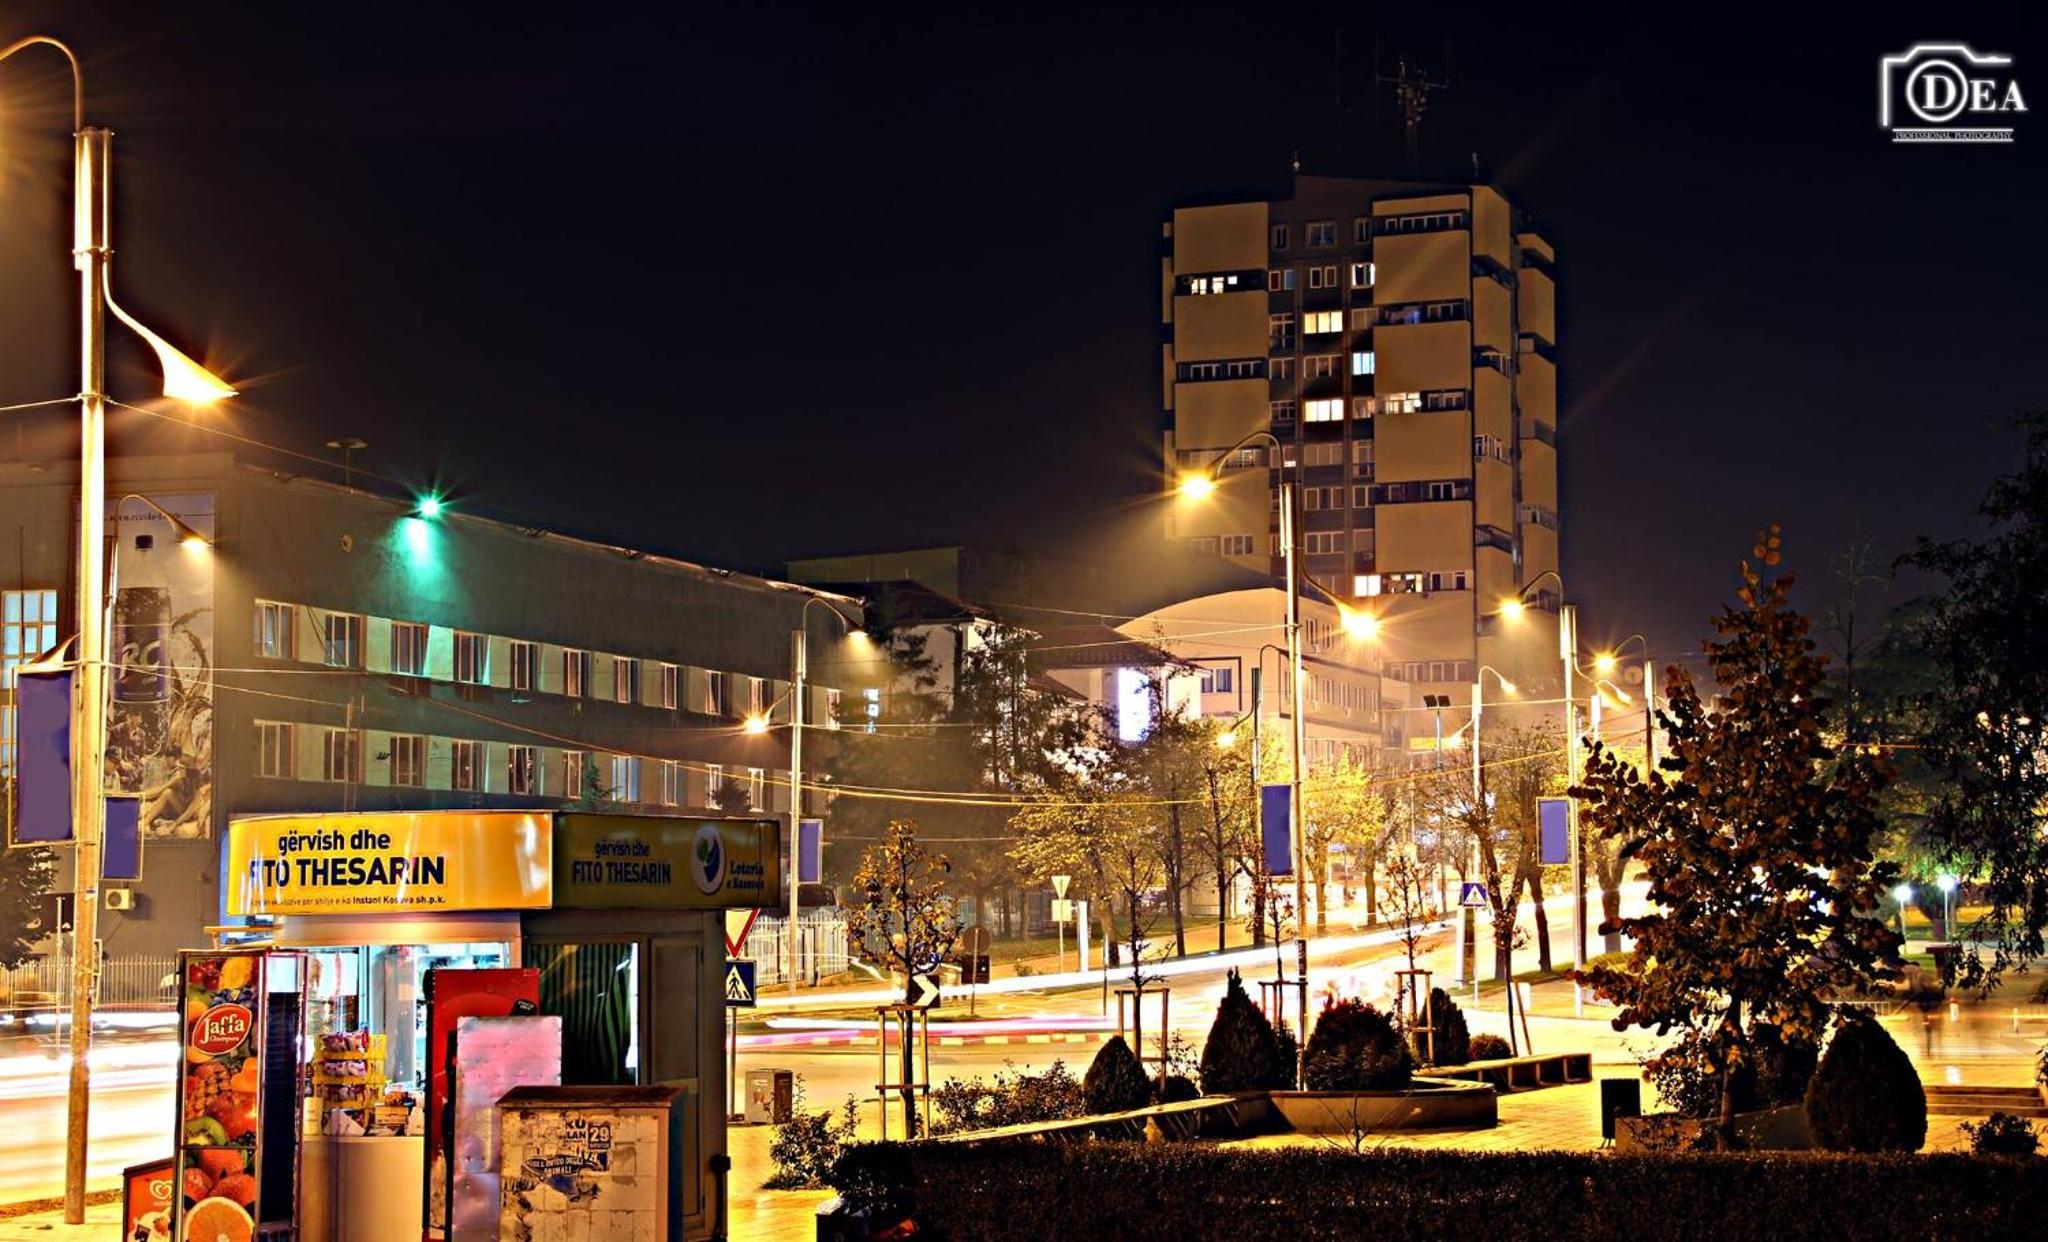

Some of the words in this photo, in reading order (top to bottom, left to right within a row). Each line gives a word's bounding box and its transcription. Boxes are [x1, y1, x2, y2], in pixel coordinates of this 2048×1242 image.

[278, 830, 345, 854] gërvish
[350, 830, 391, 850] dhe
[595, 839, 630, 858] gërvish
[632, 841, 651, 857] dhe
[296, 856, 445, 887] THESARIN
[572, 860, 602, 884] FITO
[605, 861, 671, 886] THESARIN
[353, 895, 382, 905] Instant
[200, 1013, 246, 1045] Jaffa
[589, 1126, 610, 1143] 29
